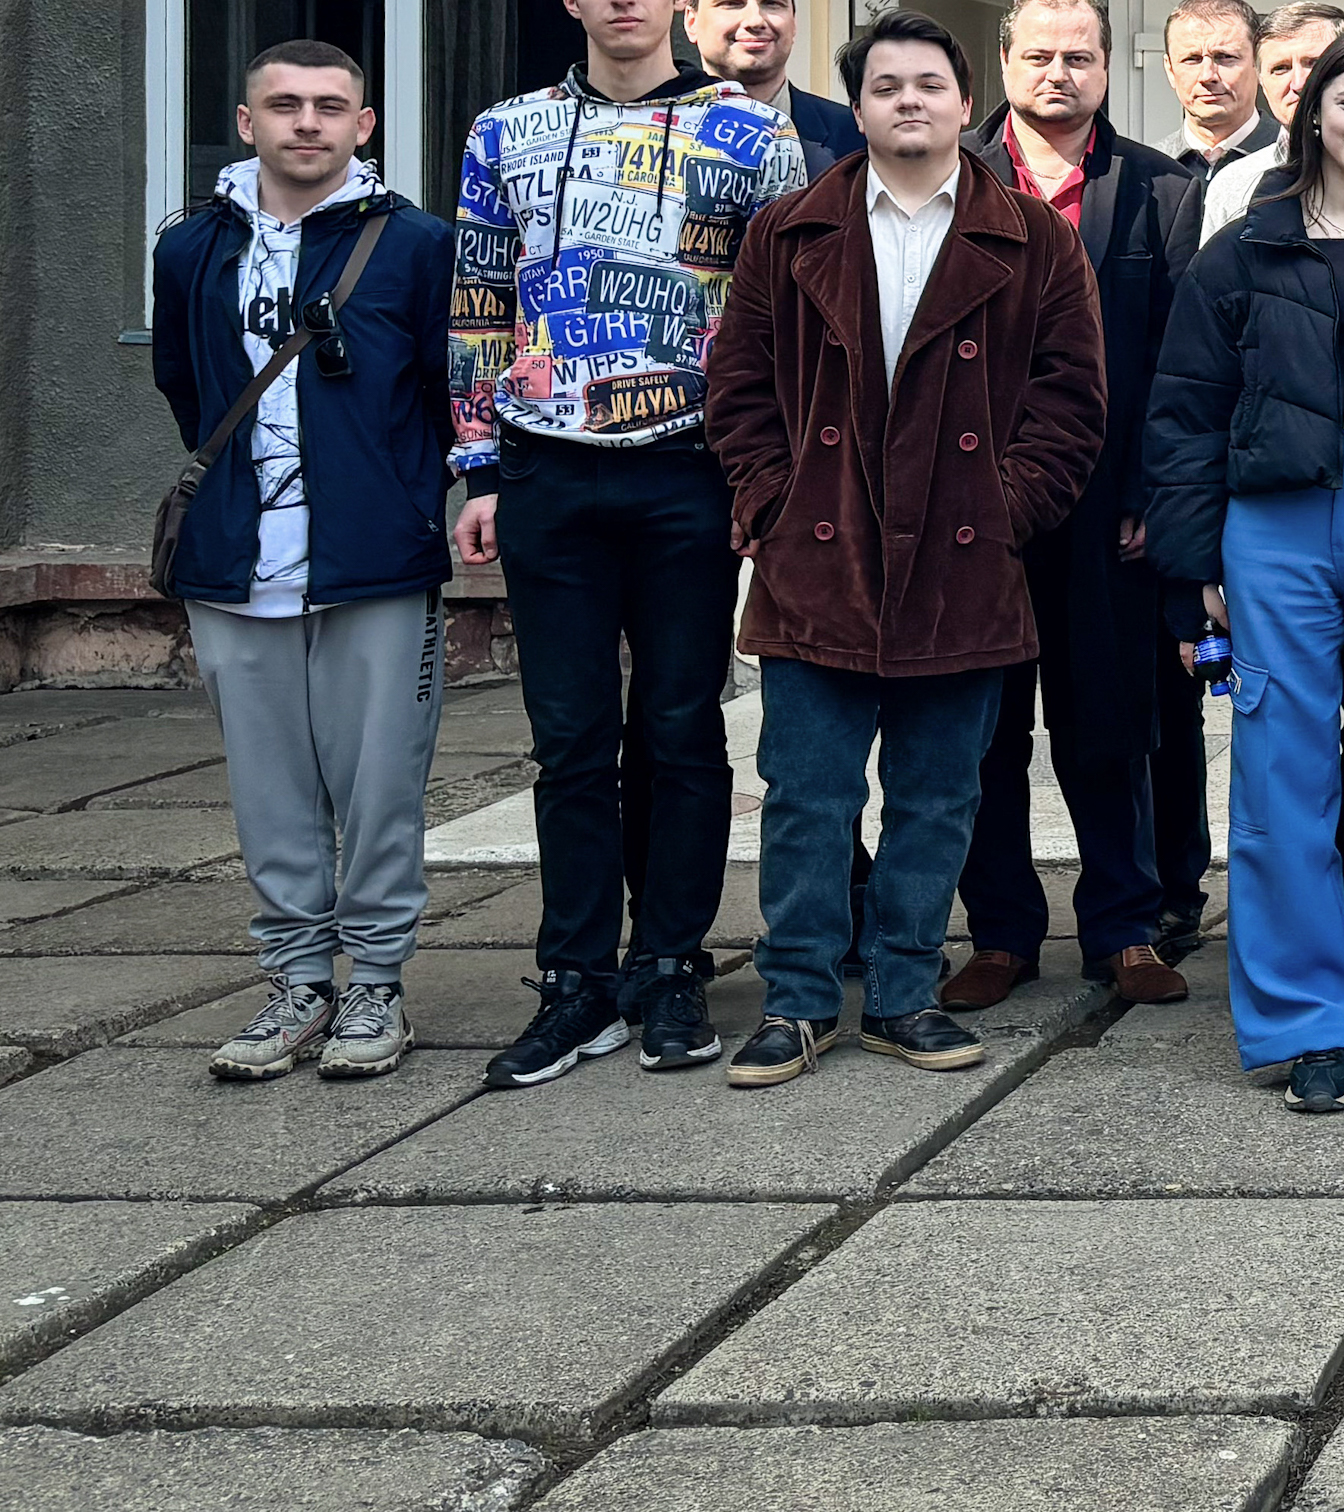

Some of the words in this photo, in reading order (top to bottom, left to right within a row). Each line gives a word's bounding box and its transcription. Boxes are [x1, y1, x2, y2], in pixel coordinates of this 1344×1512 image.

[530, 150, 565, 166] ISLAND
[571, 197, 664, 244] W2UHG
[584, 231, 616, 245] GARDEN
[617, 237, 641, 250] STATE
[528, 244, 543, 256] CT
[577, 248, 605, 263] 1950
[521, 265, 547, 283] UTAH
[600, 268, 688, 316] W2UHQ
[531, 359, 546, 370] 50
[611, 378, 637, 391] DRIVE
[638, 374, 670, 388] SAFELY
[416, 615, 438, 704] ATHLETIC
